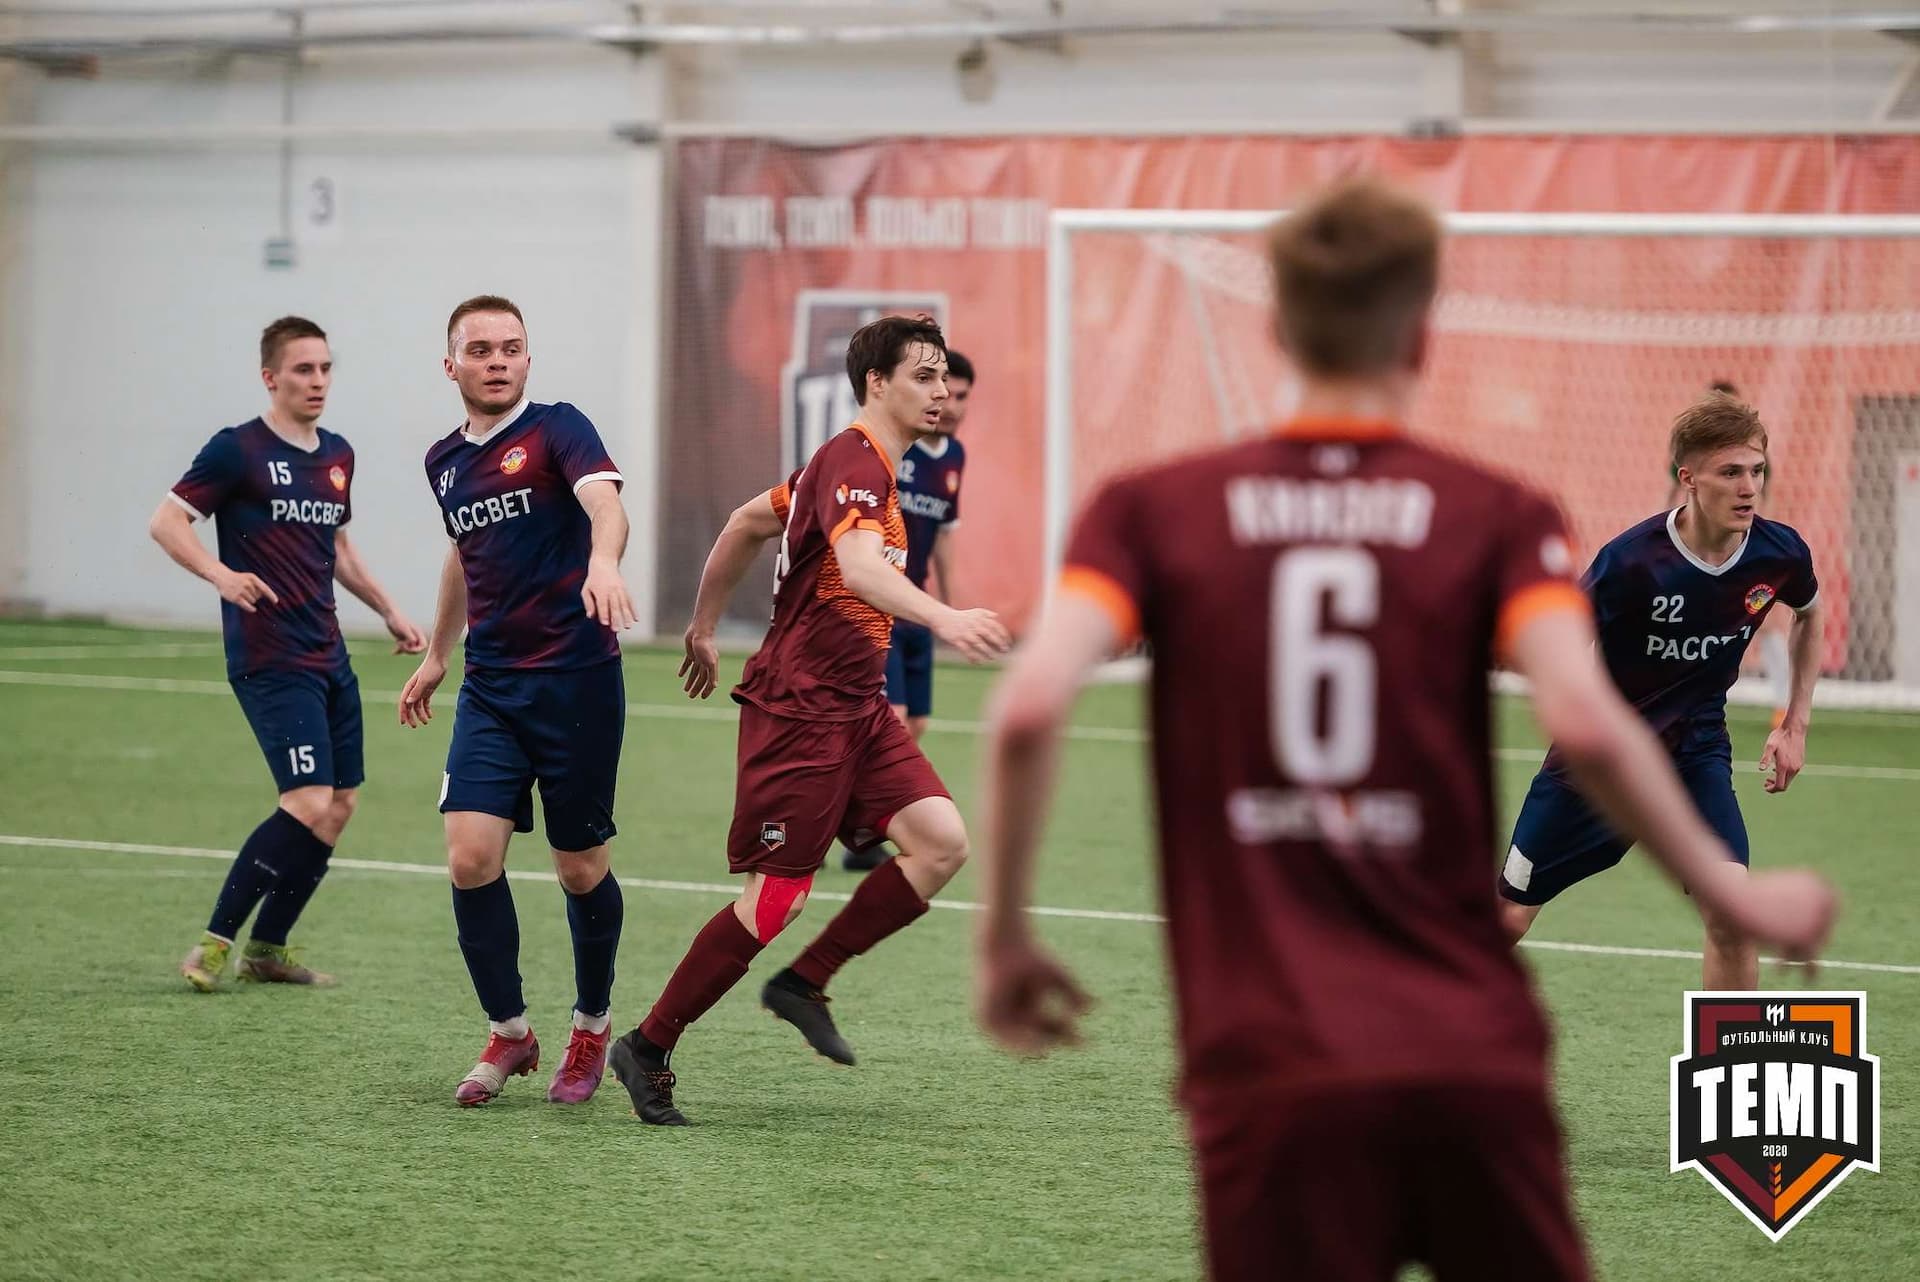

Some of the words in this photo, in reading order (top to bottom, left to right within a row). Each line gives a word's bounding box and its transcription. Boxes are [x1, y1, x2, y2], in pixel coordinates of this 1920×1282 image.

[267, 461, 292, 485] 15
[270, 499, 345, 525] РАССВЕ
[449, 488, 532, 536] АССВЕТ
[1651, 595, 1685, 623] 22
[1270, 546, 1380, 785] 6
[288, 745, 316, 776] 15
